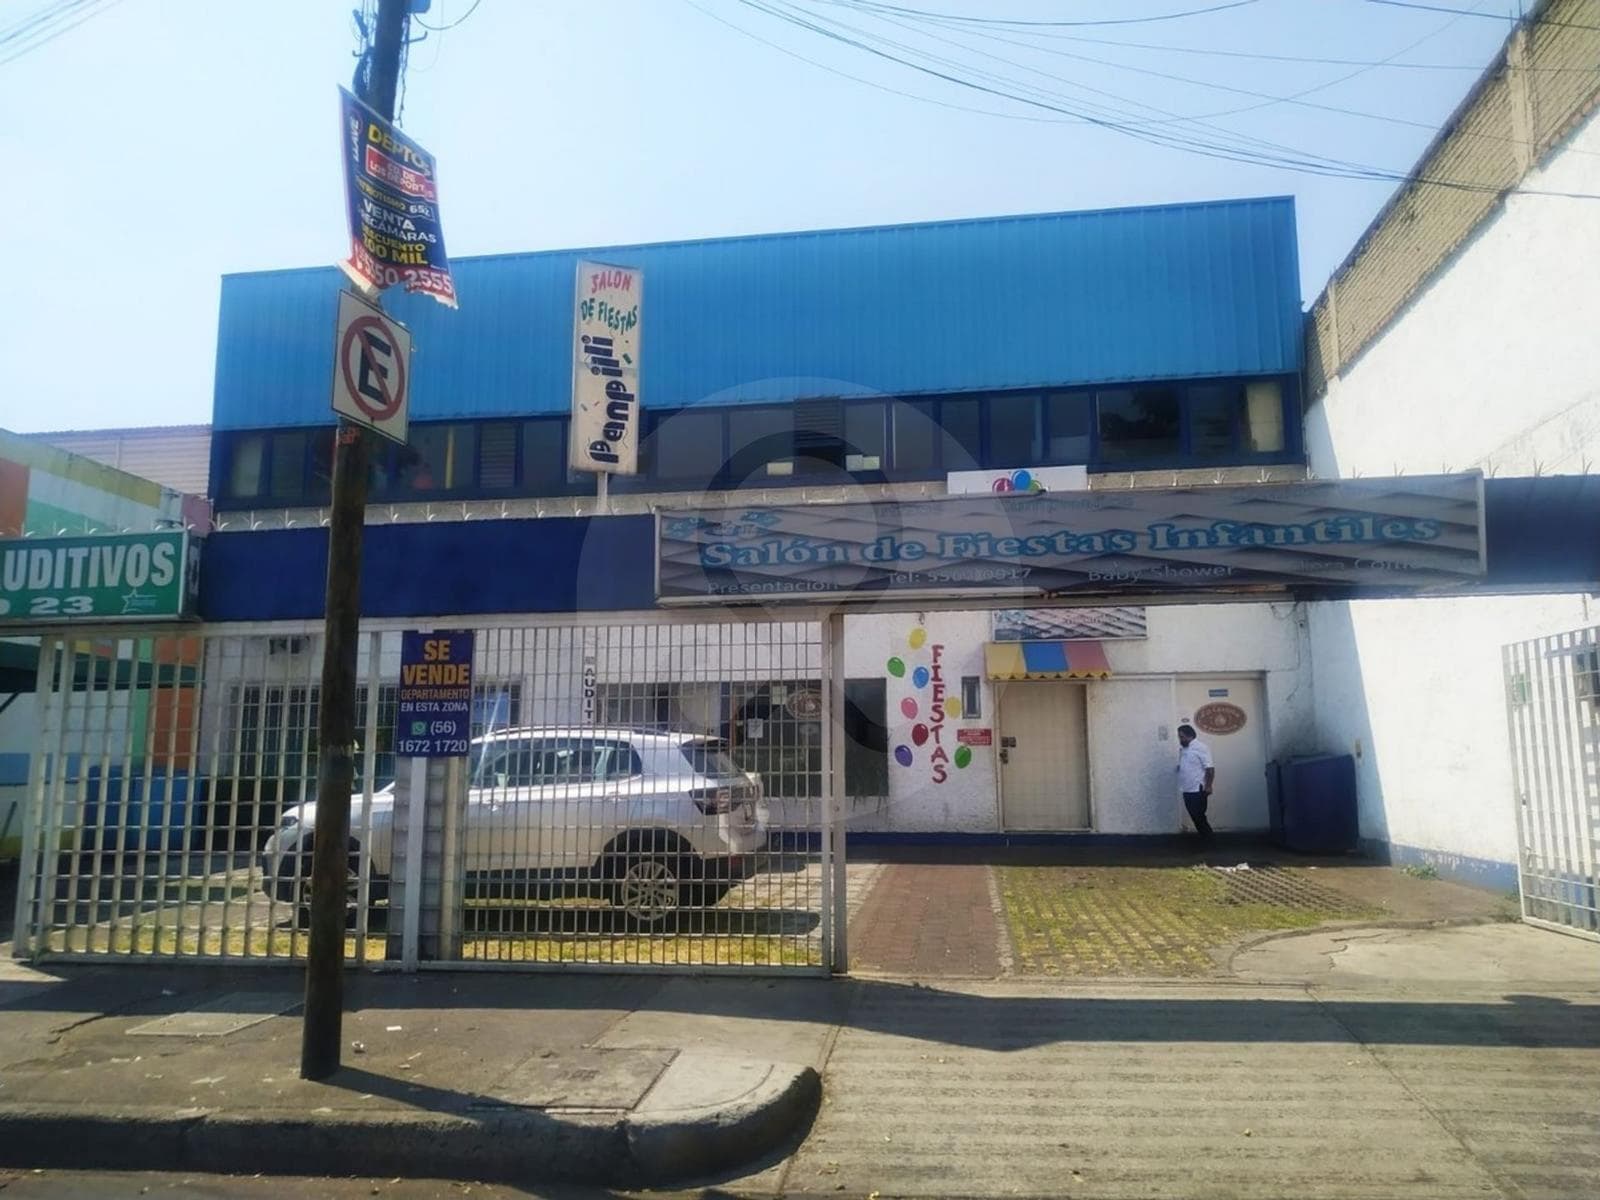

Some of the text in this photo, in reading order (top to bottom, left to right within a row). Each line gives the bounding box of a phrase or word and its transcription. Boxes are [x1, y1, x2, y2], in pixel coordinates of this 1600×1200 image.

[363, 198, 416, 231] VENTA
[391, 250, 428, 265] MIL
[581, 298, 638, 335] DE FIESTAS
[701, 514, 1442, 569] Salón de Fiestas Infantiles
[0, 542, 176, 591] UDITIVOS
[30, 596, 93, 615] 23
[424, 640, 450, 660] SE
[403, 664, 470, 686] VENDE
[401, 689, 470, 699] DEPARTAMENTO
[401, 702, 468, 712] EN ESTA ZONA
[930, 645, 949, 784] FIESTAS
[430, 721, 456, 735] (56)
[399, 741, 467, 752] 1672 1720
